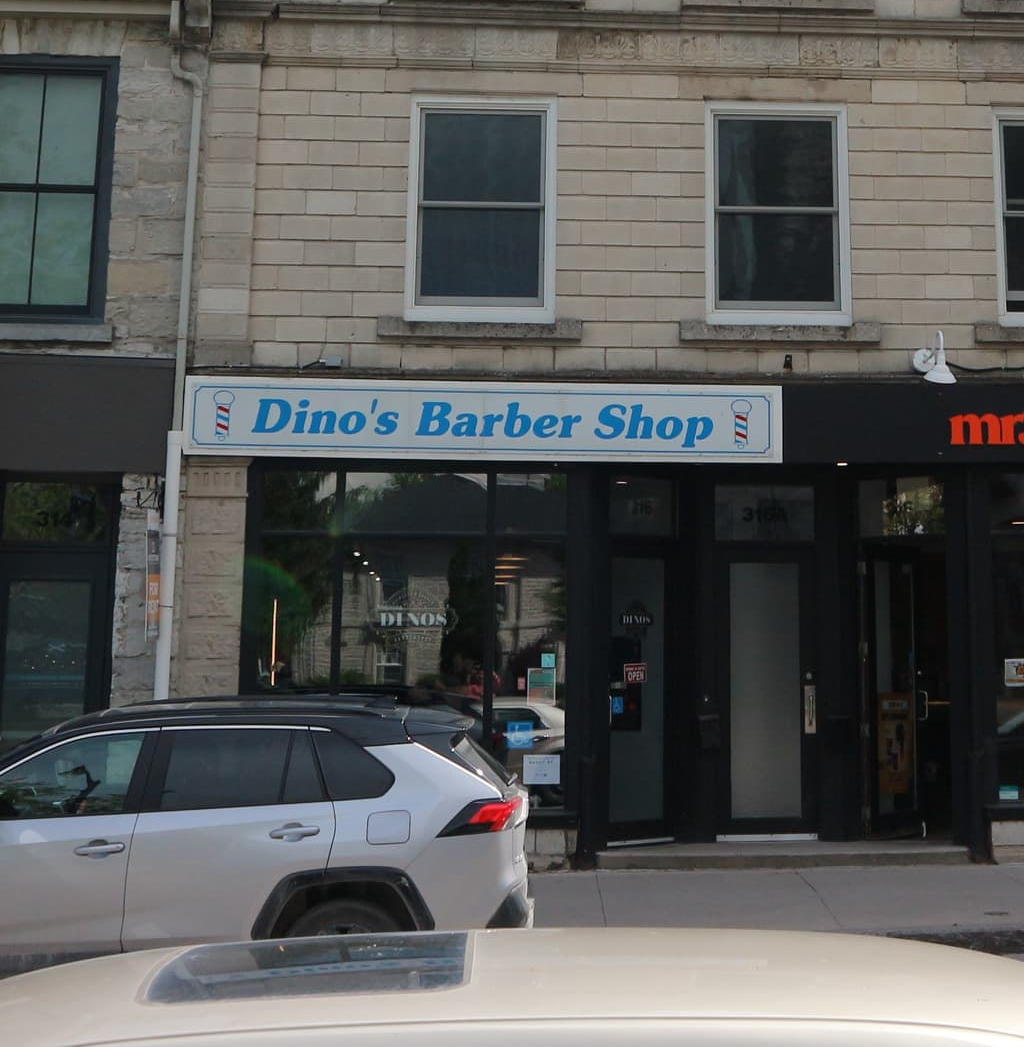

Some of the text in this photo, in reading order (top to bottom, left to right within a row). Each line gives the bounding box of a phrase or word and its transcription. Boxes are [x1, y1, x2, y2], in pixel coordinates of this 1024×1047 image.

[251, 397, 714, 448] Dino's Barber Shop
[380, 612, 448, 627] DINOS
[622, 614, 651, 625] DINOS
[627, 671, 645, 682] OPEN
